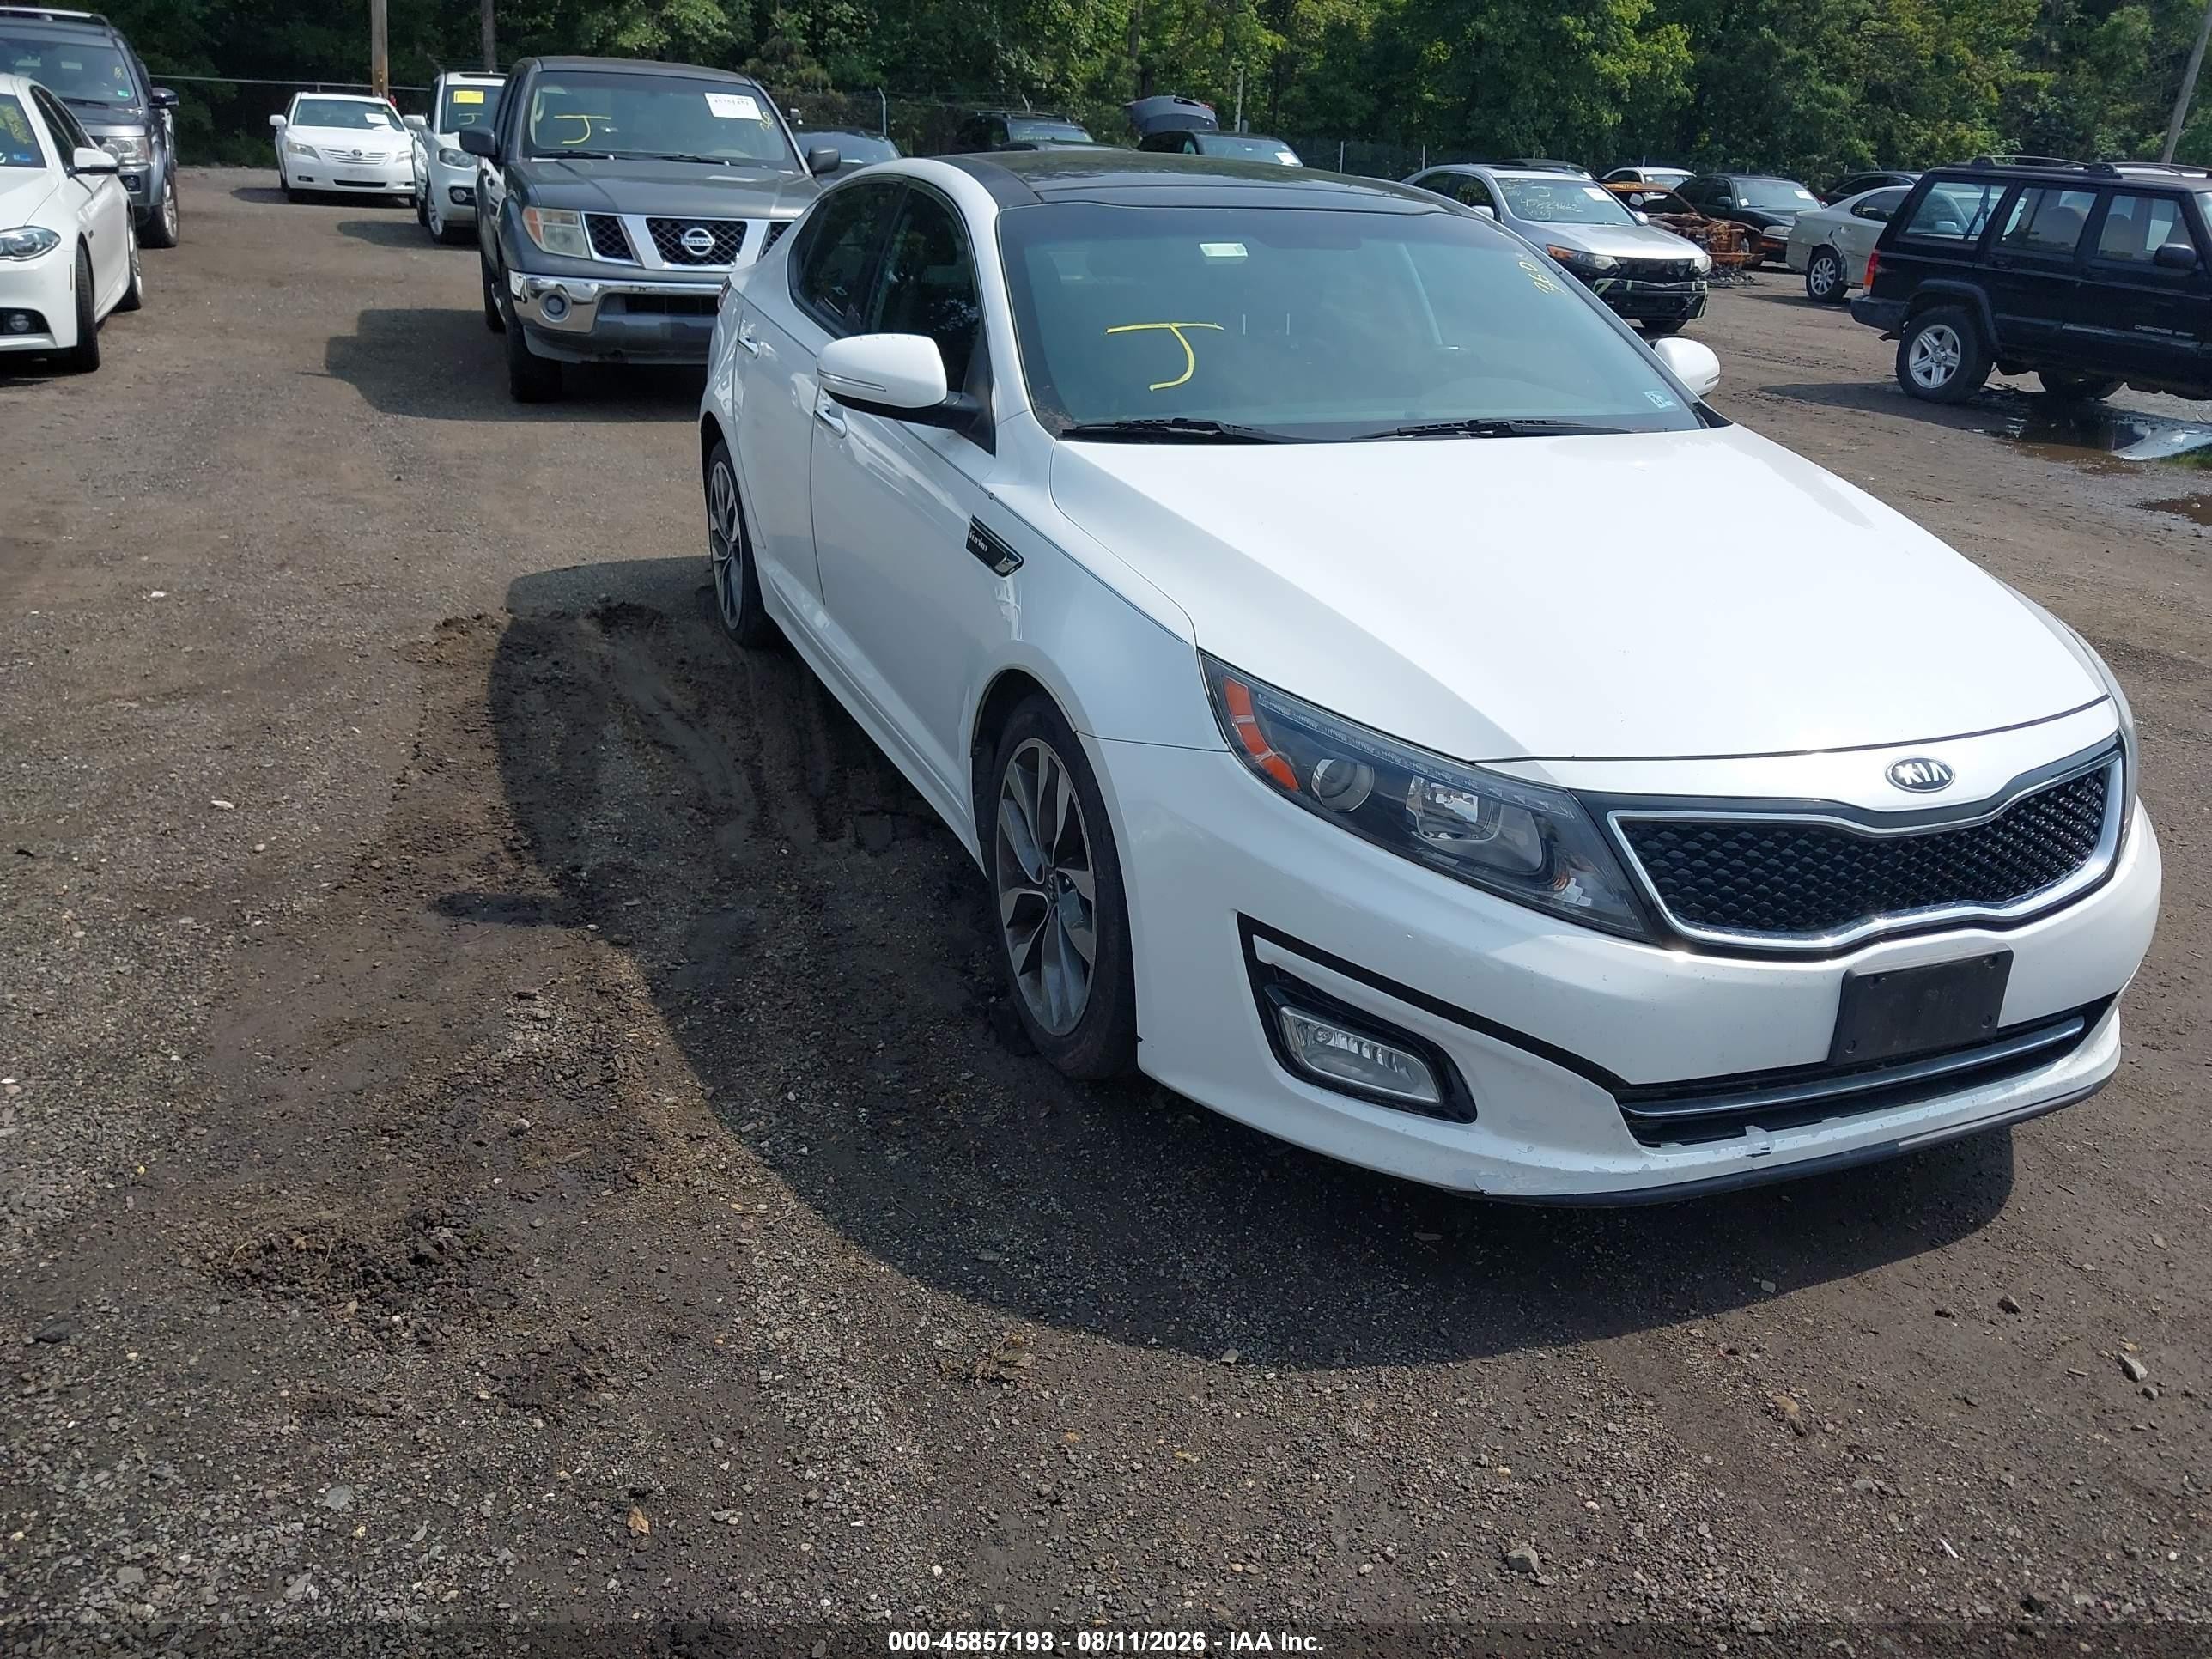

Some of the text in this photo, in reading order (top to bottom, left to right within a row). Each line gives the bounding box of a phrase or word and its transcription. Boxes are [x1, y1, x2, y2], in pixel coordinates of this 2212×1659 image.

[554, 115, 612, 144] J
[1106, 322, 1225, 392] J
[1895, 762, 1950, 785] KIA
